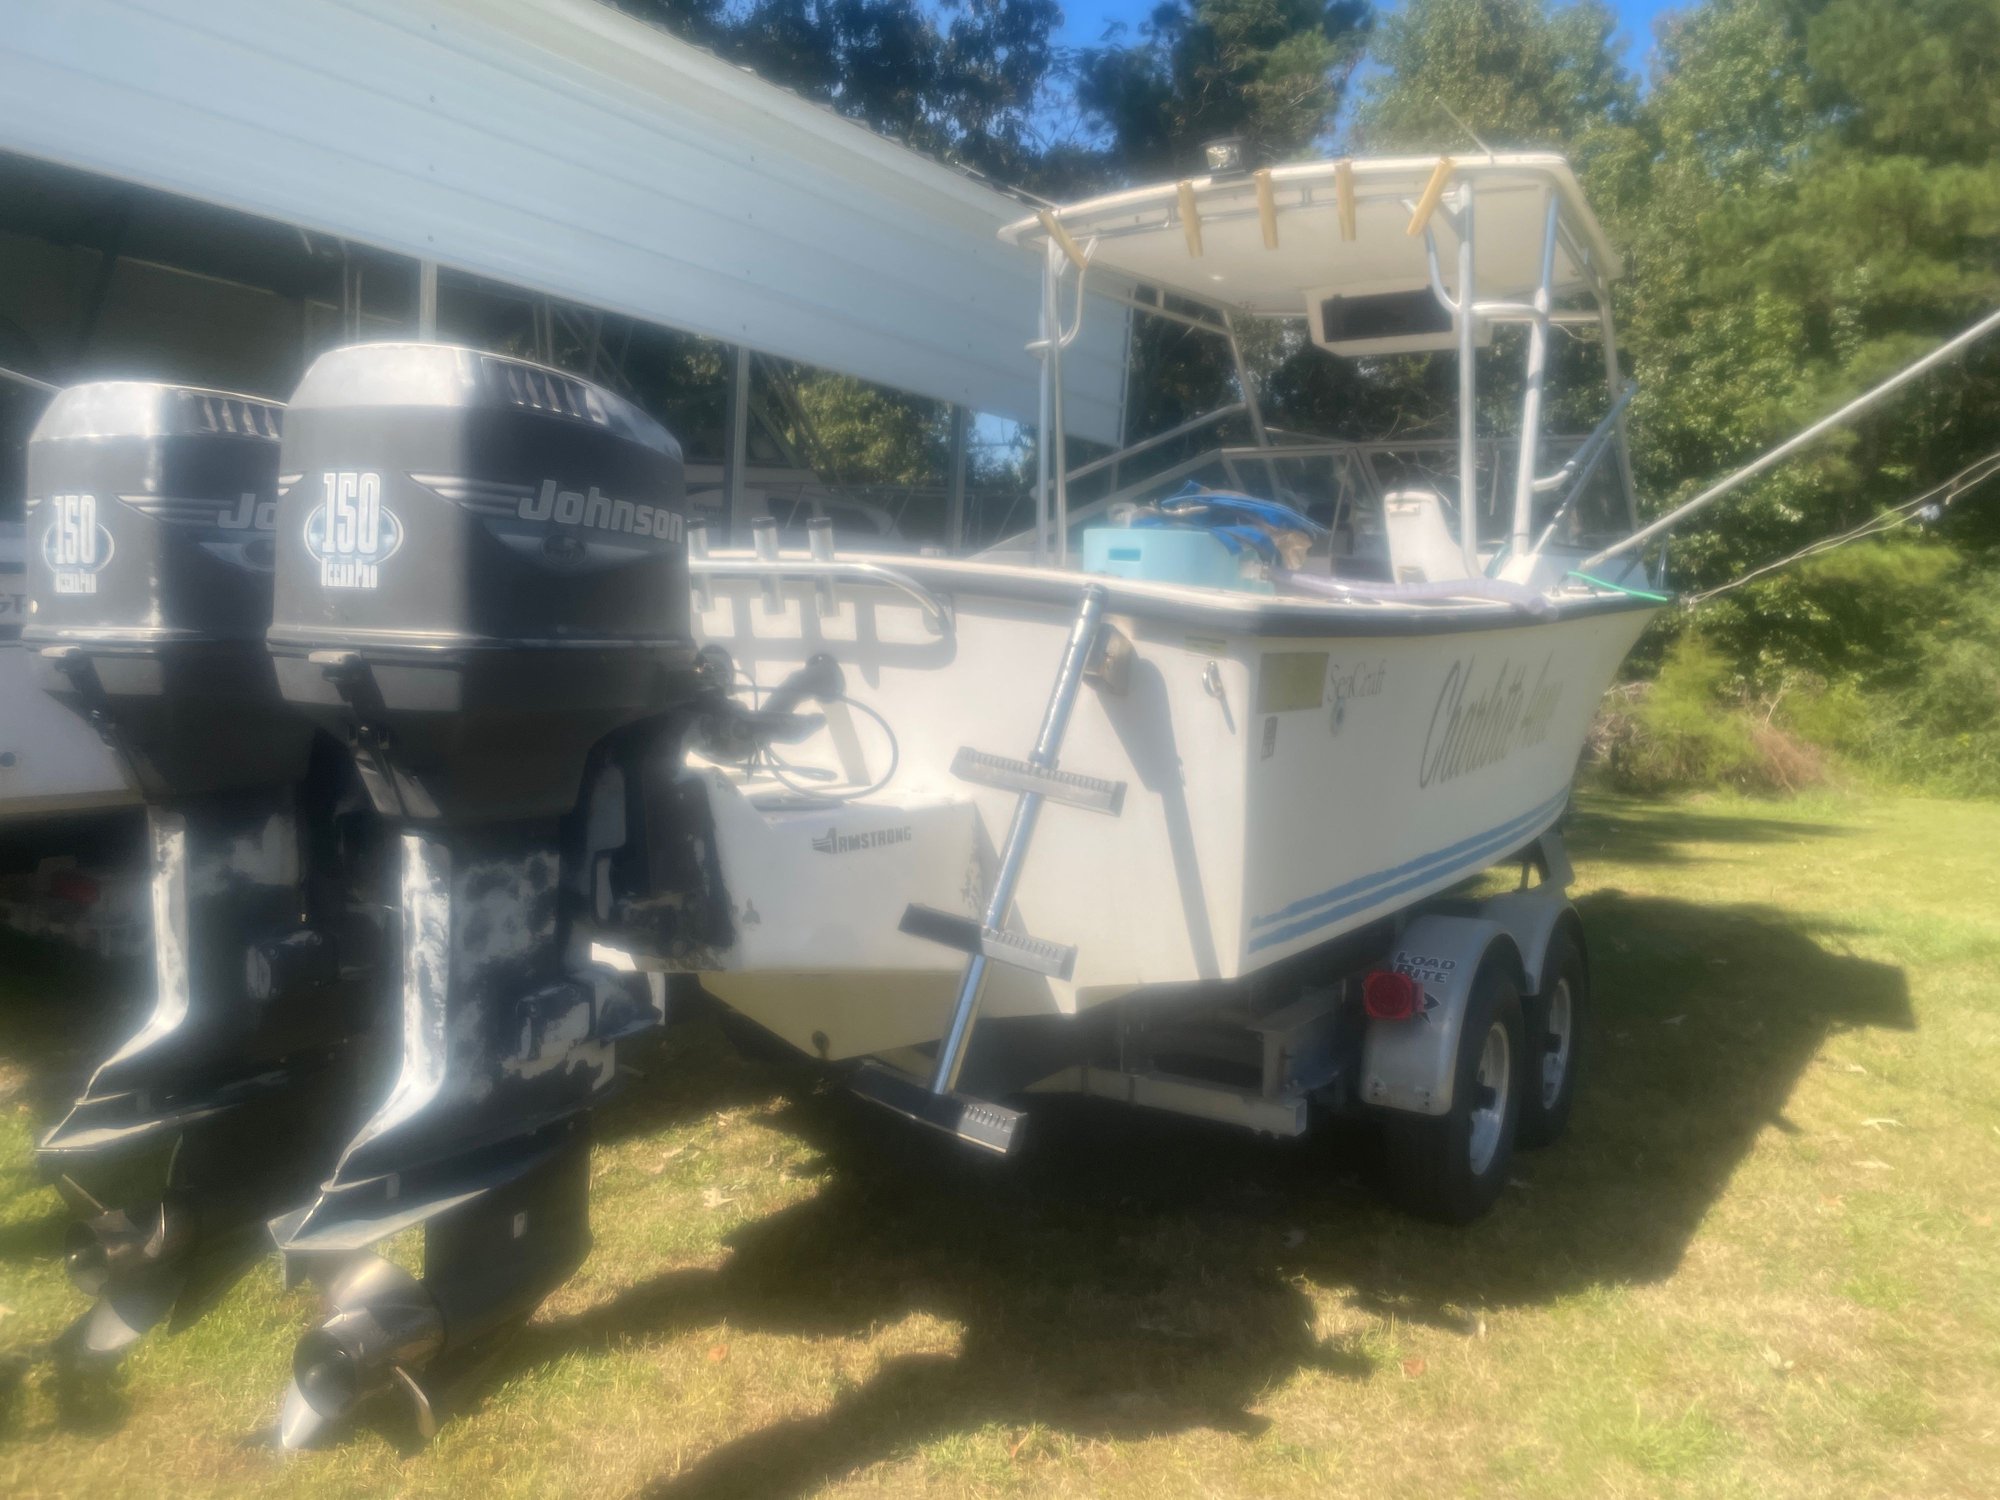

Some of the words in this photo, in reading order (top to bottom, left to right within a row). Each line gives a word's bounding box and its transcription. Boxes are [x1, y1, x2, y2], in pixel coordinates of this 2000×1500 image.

[54, 495, 96, 564] 150
[323, 472, 381, 554] 150
[518, 479, 684, 544] Johnson
[812, 827, 912, 854] ARMSTRONG
[1393, 951, 1457, 970] LOAD
[1393, 963, 1450, 983] RITE
